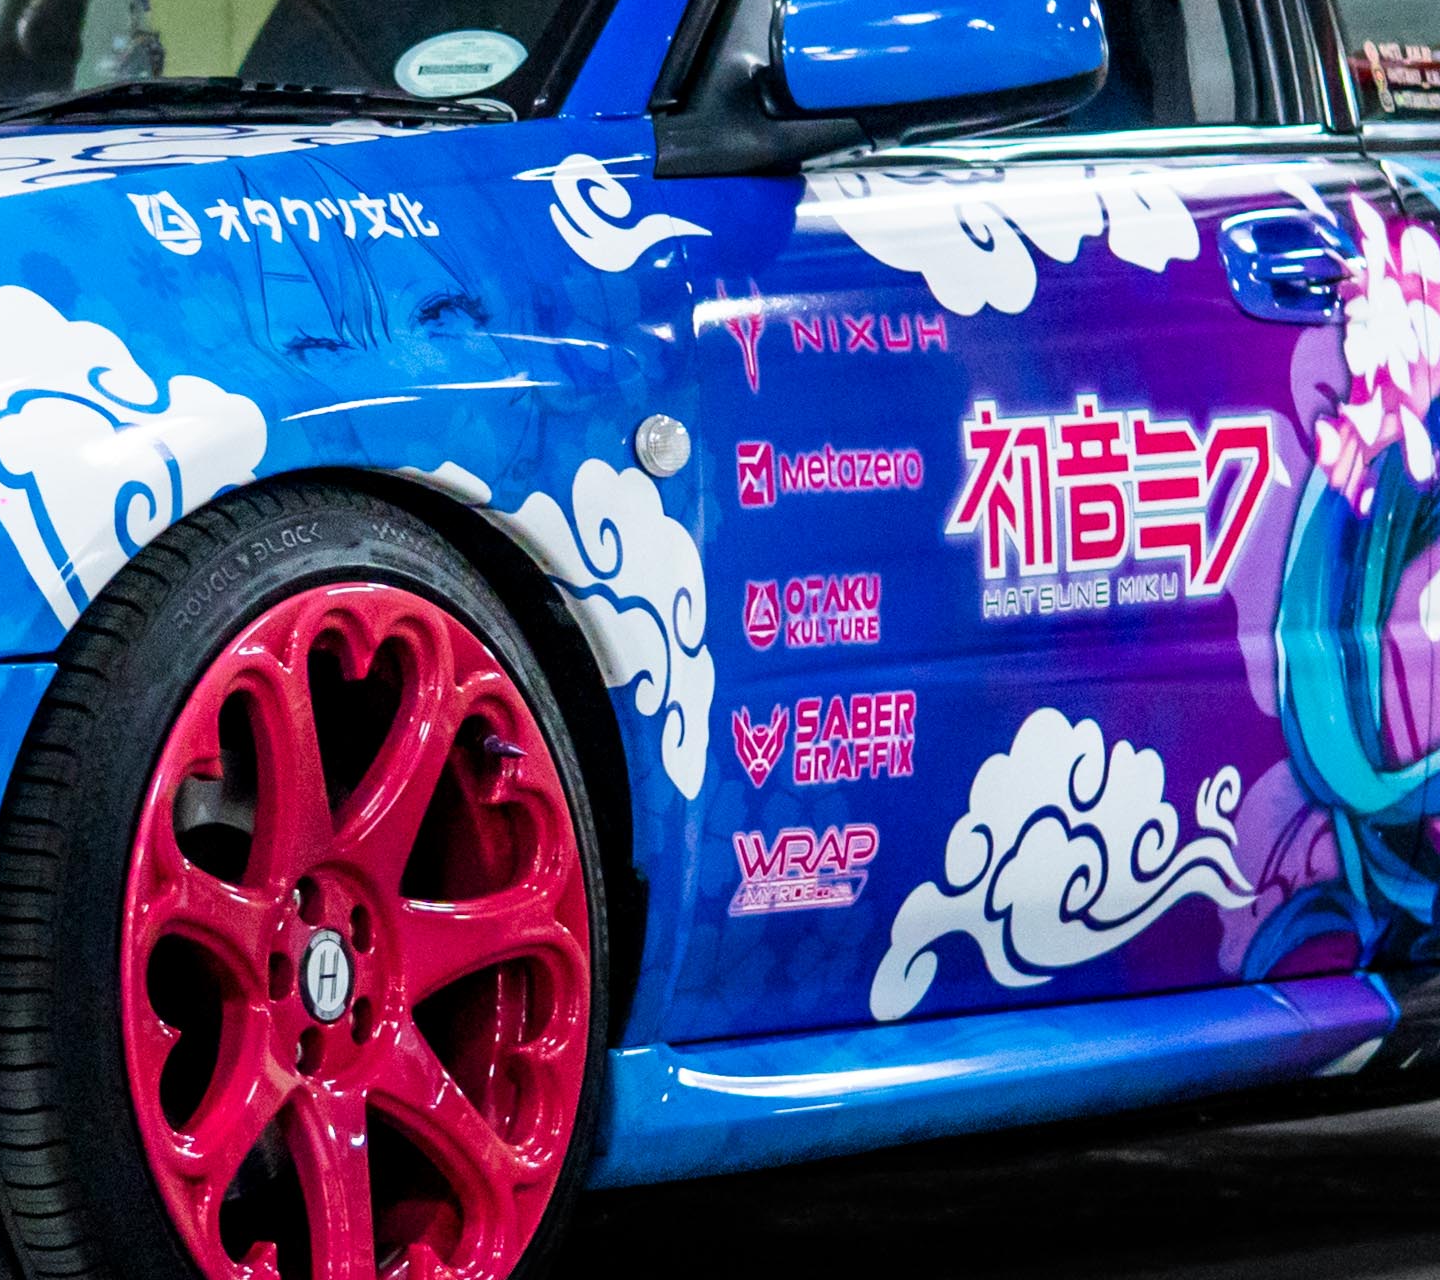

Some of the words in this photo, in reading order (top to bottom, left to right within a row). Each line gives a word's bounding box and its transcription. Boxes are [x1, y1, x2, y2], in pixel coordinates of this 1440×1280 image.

[790, 314, 948, 352] NIXUH
[779, 442, 923, 492] Metazero
[785, 575, 881, 614] OTAKU
[983, 580, 1109, 617] HATSUNE
[1118, 572, 1178, 604] MIKU
[786, 614, 881, 648] KULTURE
[796, 691, 916, 744] SABER
[793, 740, 914, 784] GRAFFIX
[733, 824, 878, 879] WRAP
